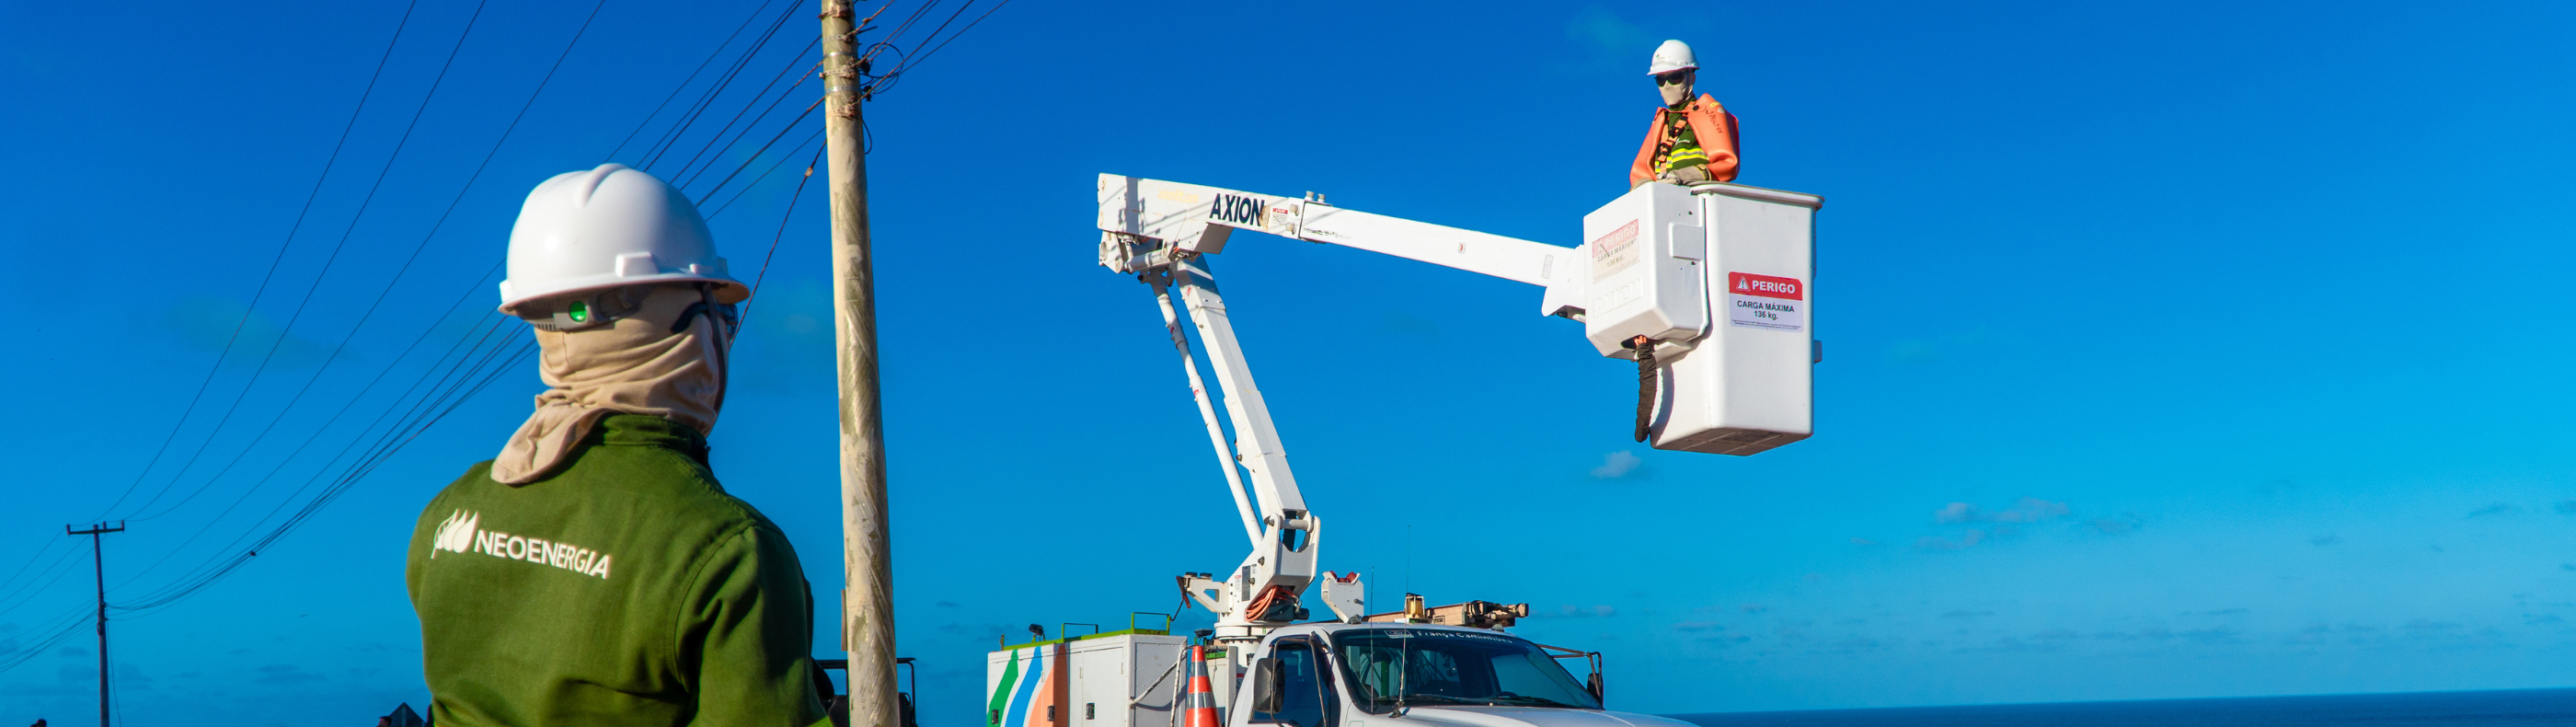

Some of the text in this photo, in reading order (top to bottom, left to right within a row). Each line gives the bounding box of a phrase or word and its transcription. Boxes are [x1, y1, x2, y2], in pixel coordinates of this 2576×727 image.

[1209, 193, 1265, 226] AXION
[1604, 225, 1636, 248] PERIGO
[1597, 250, 1614, 262] CARGA
[1752, 280, 1796, 294] PERIGO
[1737, 300, 1795, 313] CARGA MÁXIMA
[1754, 310, 1778, 321] 136 kg.
[473, 529, 611, 579] NEOENERGIA
